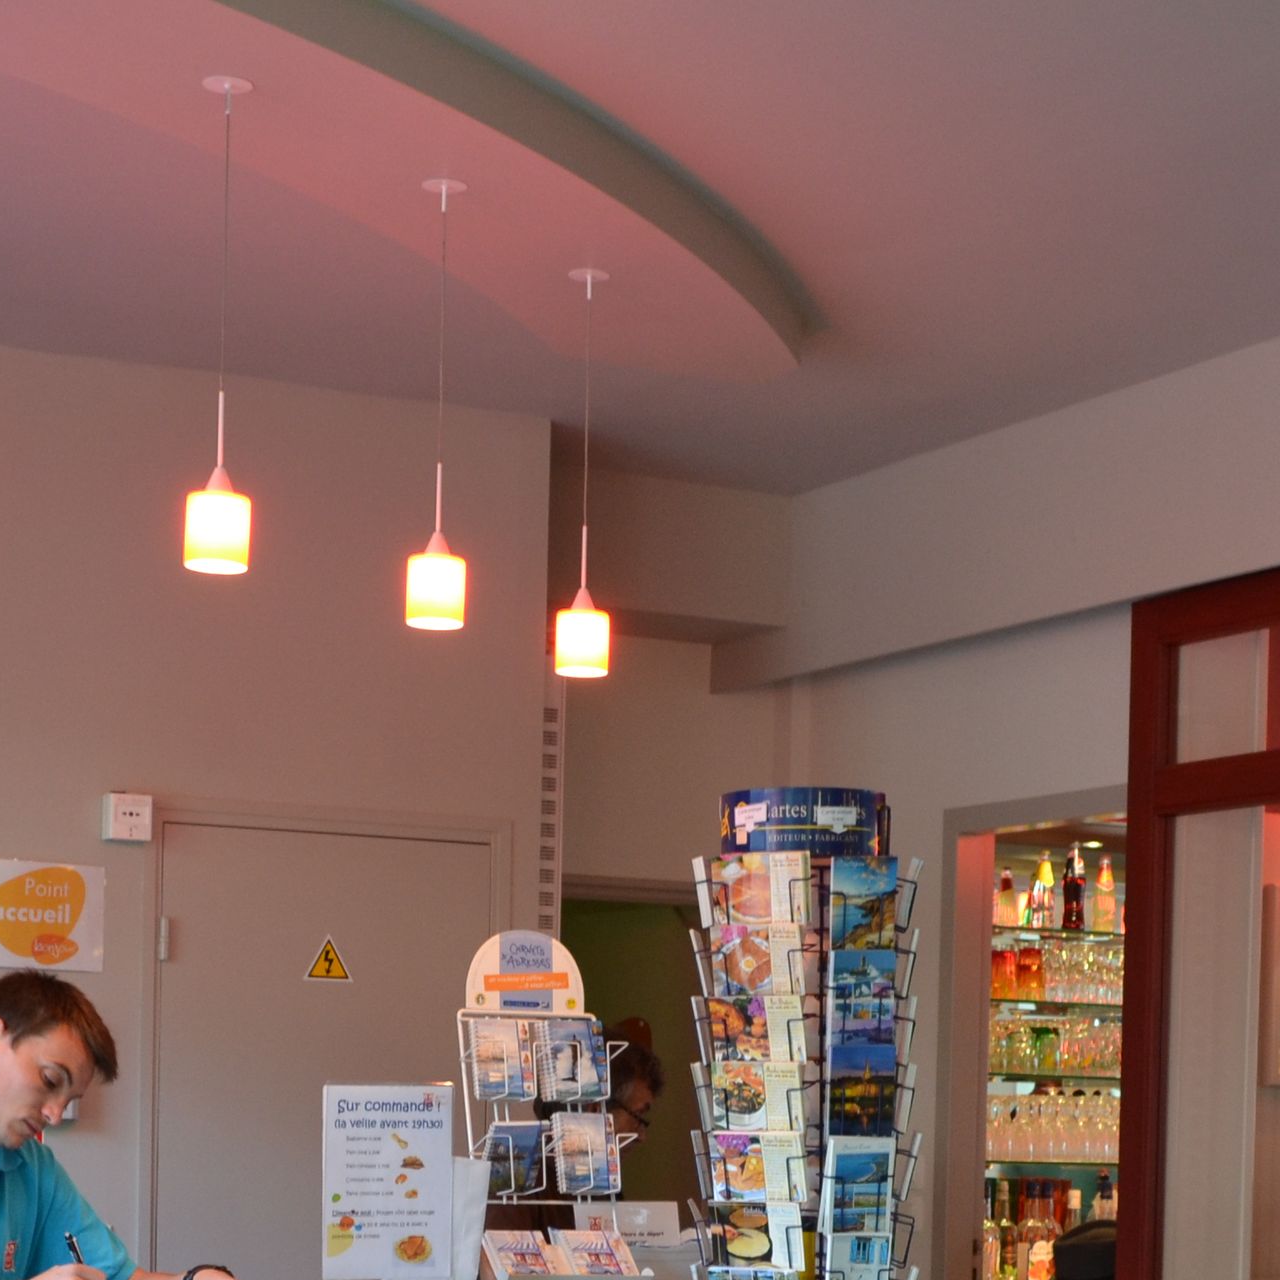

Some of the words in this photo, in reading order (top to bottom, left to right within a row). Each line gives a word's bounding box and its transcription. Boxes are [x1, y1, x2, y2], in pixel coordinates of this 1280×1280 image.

[815, 833, 859, 843] FABRICANT
[25, 877, 69, 897] Point
[337, 1098, 360, 1114] Sur
[364, 1098, 433, 1112] commande
[334, 1118, 346, 1129] (la
[349, 1118, 377, 1129] veille
[380, 1118, 409, 1129] avant
[411, 1118, 443, 1130] 19h30)
